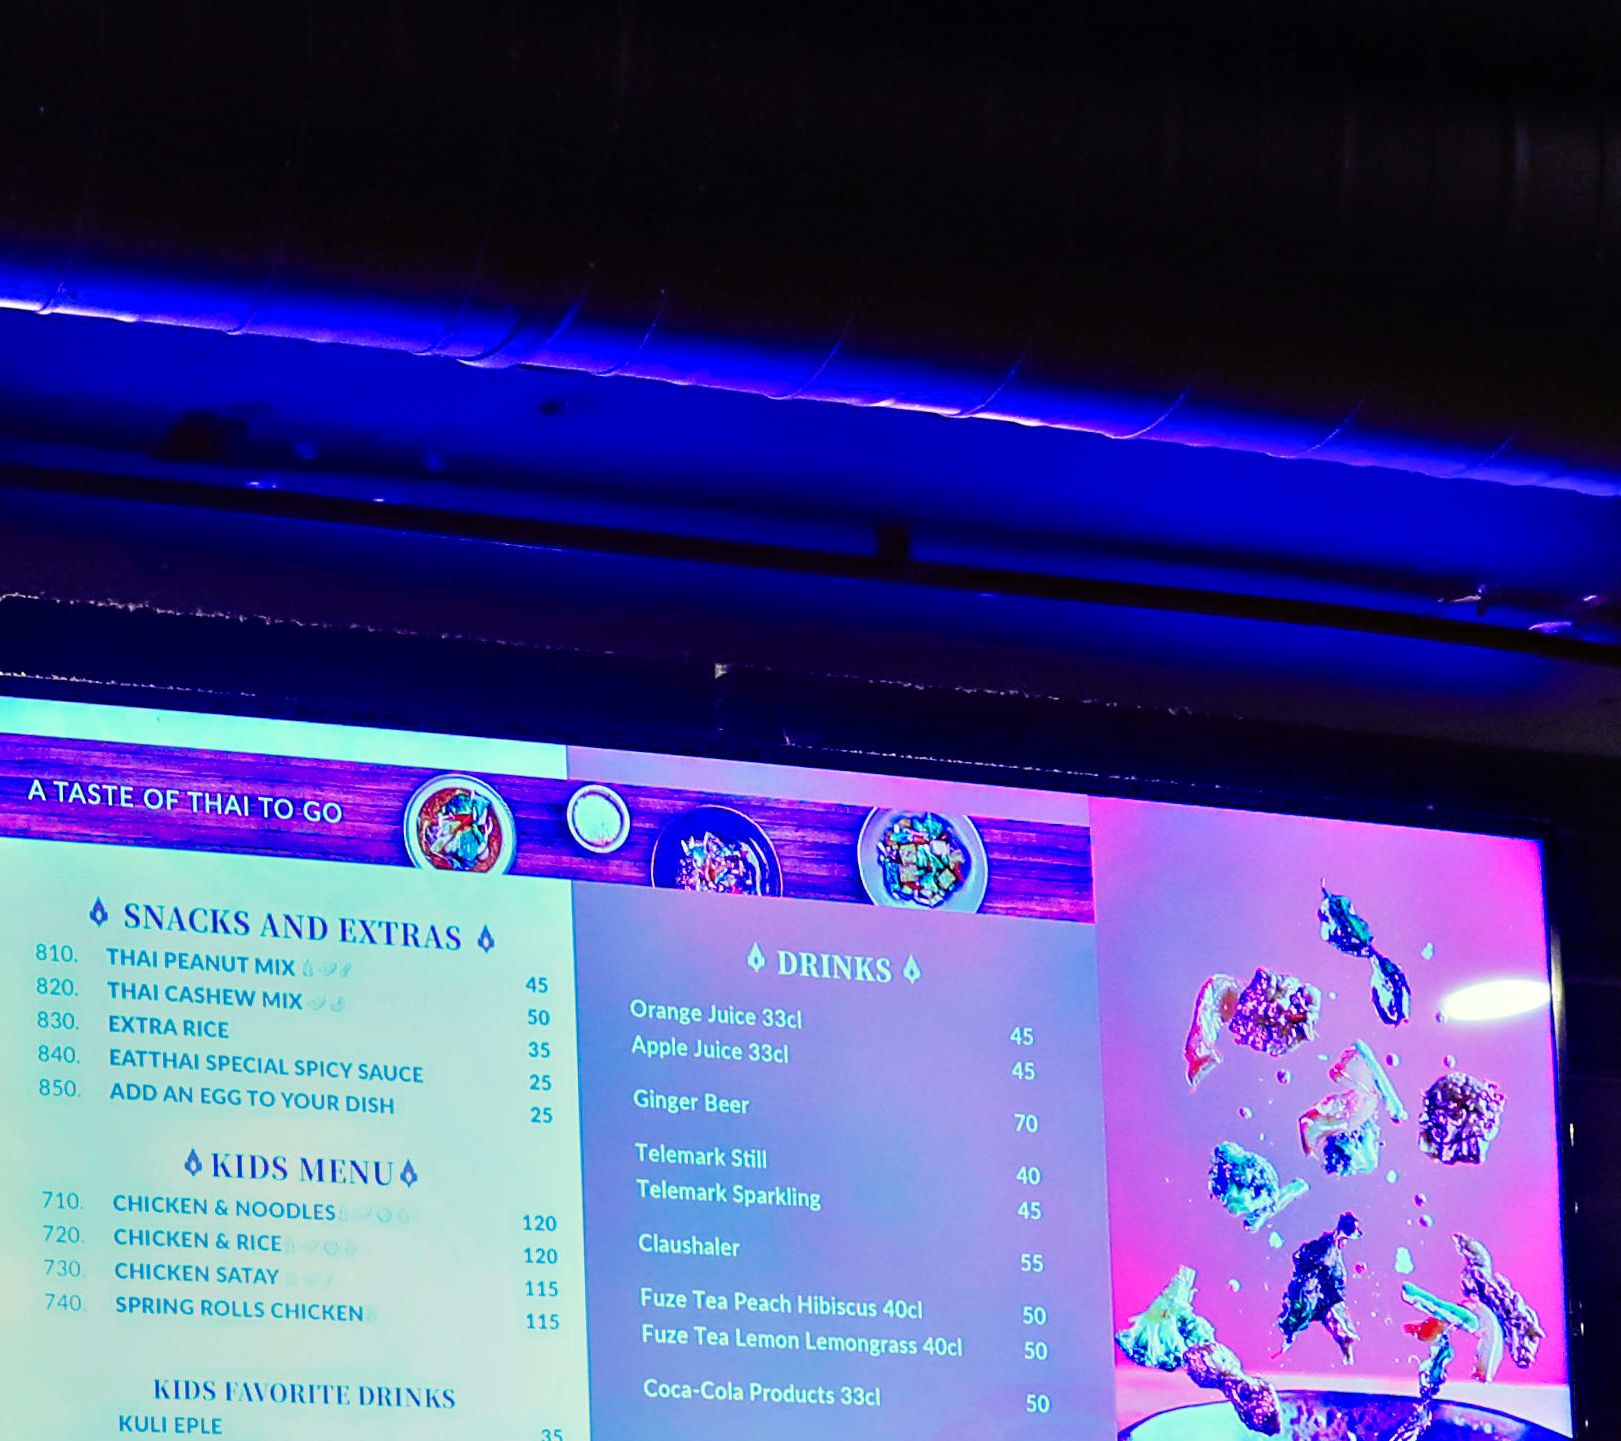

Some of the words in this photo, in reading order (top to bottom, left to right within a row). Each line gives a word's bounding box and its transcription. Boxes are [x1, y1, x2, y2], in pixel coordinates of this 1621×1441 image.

[26, 780, 47, 800] A
[53, 781, 135, 807] TASTE
[143, 789, 179, 810] OF
[187, 792, 253, 816] THAI
[258, 797, 295, 819] TO
[301, 799, 343, 823] GO
[125, 903, 249, 936] SNACKS
[260, 913, 327, 940] AND
[339, 918, 461, 950] EXTRAS
[106, 948, 157, 968] THAI
[165, 952, 249, 973] PEANUT
[255, 958, 295, 976] MIX
[526, 976, 548, 993] 45
[778, 951, 893, 982] DRINKS
[109, 1015, 178, 1036] EXTRA
[184, 1020, 229, 1039] RICE
[529, 1041, 550, 1058] 35
[629, 1000, 703, 1024] Orange
[708, 1005, 755, 1025] Juice
[763, 1009, 803, 1028] 33cl
[1011, 1028, 1035, 1045] 45
[110, 1049, 199, 1070] EATTHAI
[207, 1054, 289, 1075] SPECIAL
[295, 1060, 353, 1079] SPICY
[359, 1064, 423, 1083] SAUCE
[530, 1074, 551, 1091] 25
[634, 1089, 698, 1113] Ginger
[705, 1094, 749, 1113] Beer
[1015, 1114, 1038, 1132] 70
[213, 1153, 287, 1180] KIDS
[301, 1158, 393, 1186] MENU
[637, 1179, 726, 1202] Telemark
[733, 1185, 821, 1211] Sparkling
[1018, 1202, 1043, 1219] 45
[639, 1234, 739, 1256] Claushaler
[1022, 1254, 1045, 1272] 55
[117, 1296, 194, 1315] SPRING
[201, 1300, 264, 1317] ROLLS
[271, 1303, 363, 1322] CHICKEN
[527, 1313, 559, 1330] 115
[155, 1379, 215, 1400] KIDS
[226, 1382, 349, 1405] FAVORITE
[359, 1386, 455, 1408] DRINKS
[644, 1379, 743, 1400] Coca-Cola
[750, 1383, 834, 1404] Products
[841, 1387, 882, 1405] 33cl
[1027, 1395, 1052, 1412] 50
